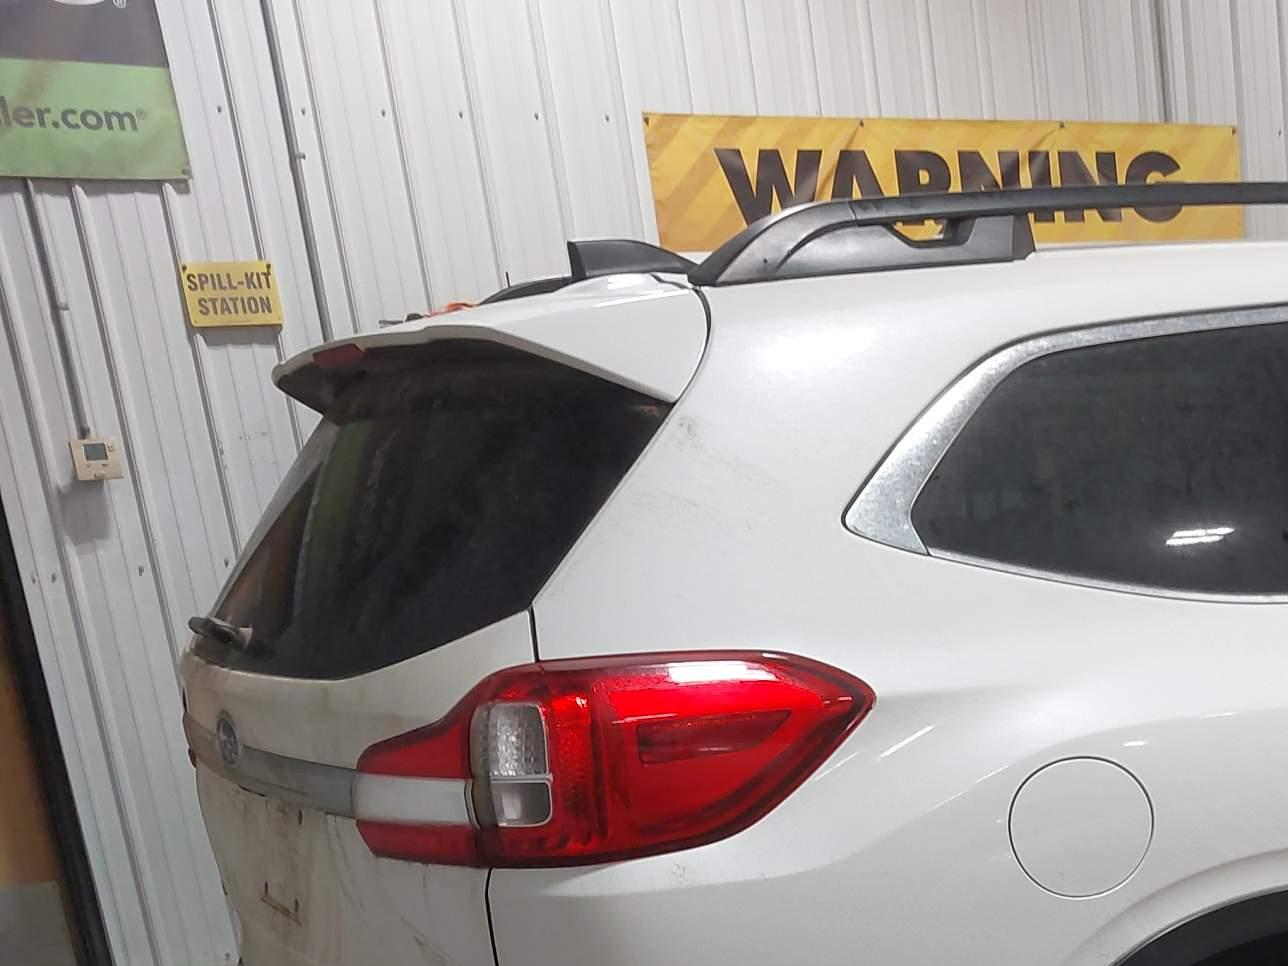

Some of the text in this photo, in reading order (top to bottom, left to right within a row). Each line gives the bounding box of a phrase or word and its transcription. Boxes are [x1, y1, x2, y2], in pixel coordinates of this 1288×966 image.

[0, 95, 138, 131] ler.com
[714, 147, 1184, 226] WARNING
[186, 272, 271, 291] SPILL-KIT
[198, 296, 272, 315] STATION
